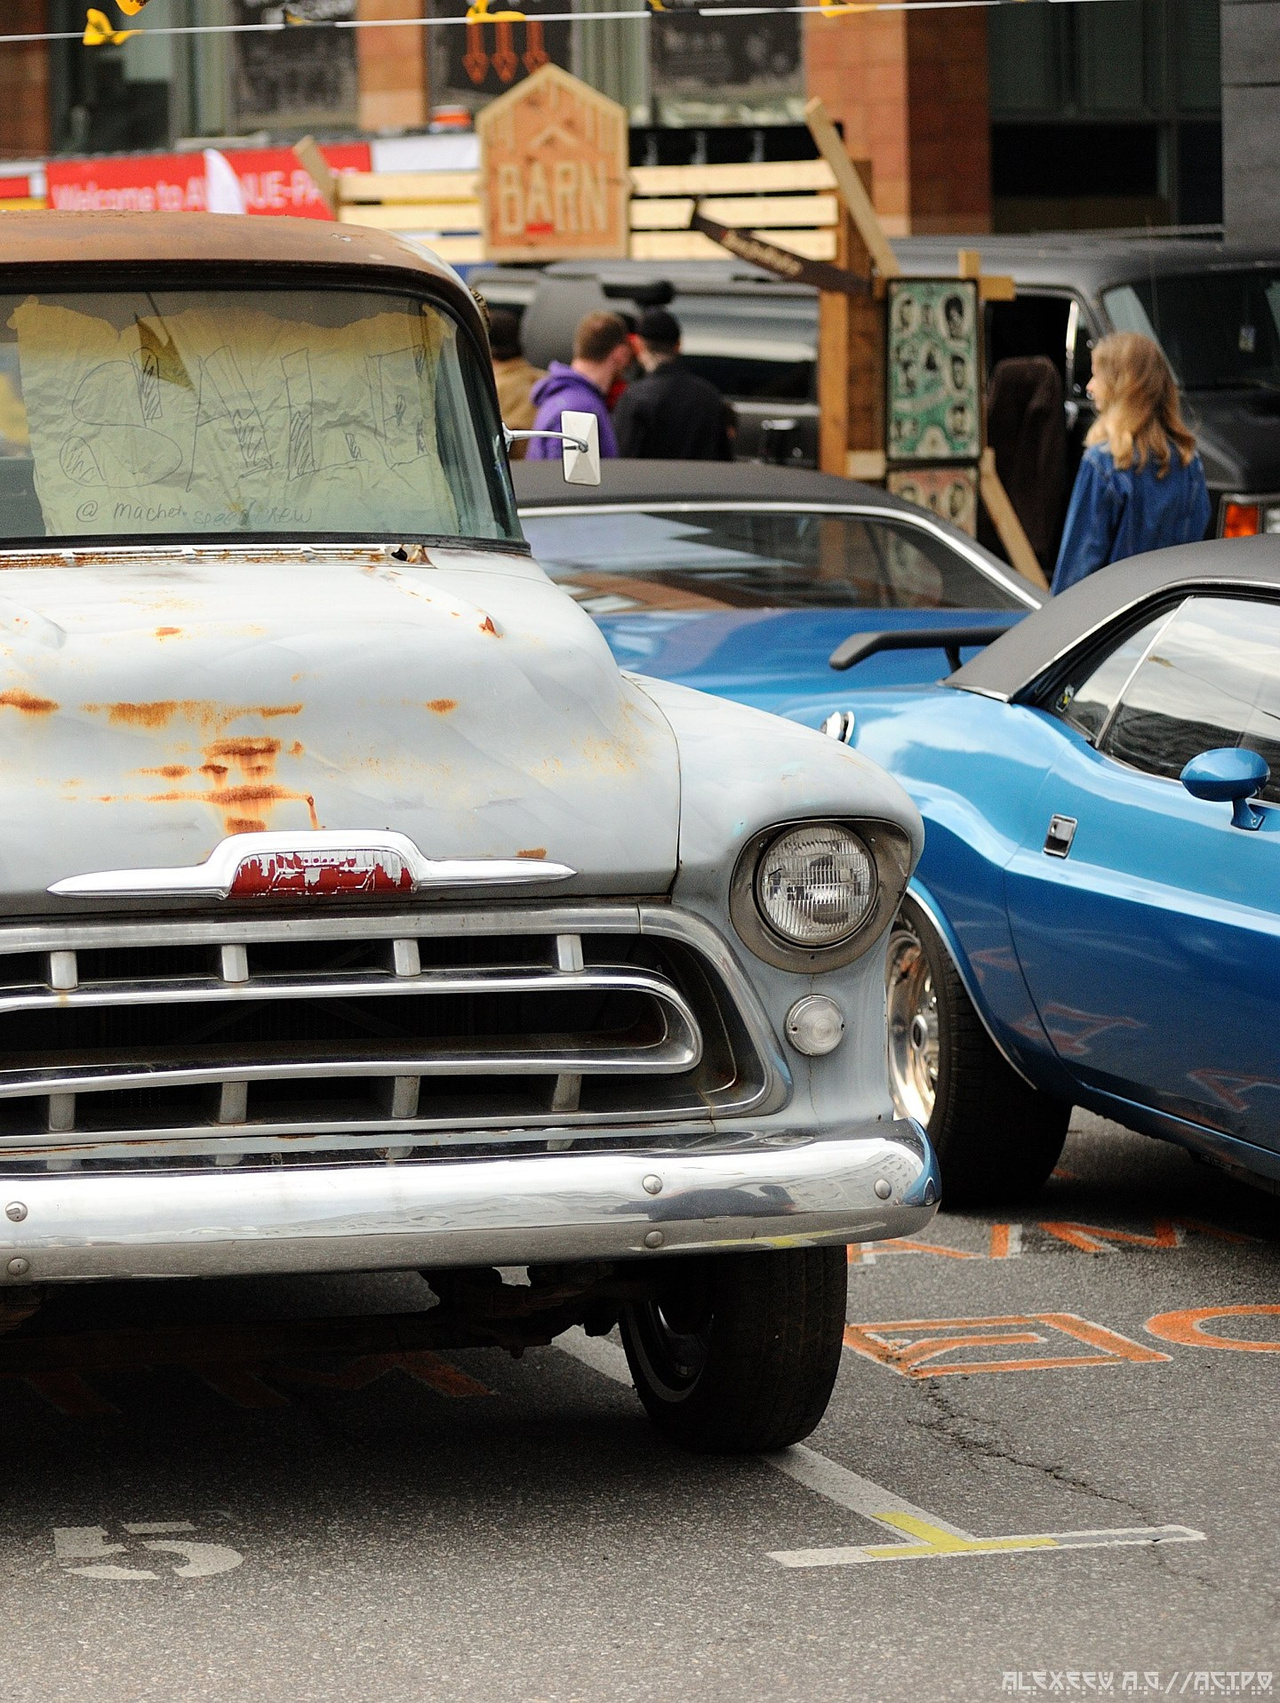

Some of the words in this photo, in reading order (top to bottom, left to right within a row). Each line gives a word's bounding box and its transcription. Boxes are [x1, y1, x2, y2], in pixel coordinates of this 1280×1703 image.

[156, 180, 184, 211] to
[498, 163, 609, 236] BARN
[53, 1521, 245, 1580] 5
